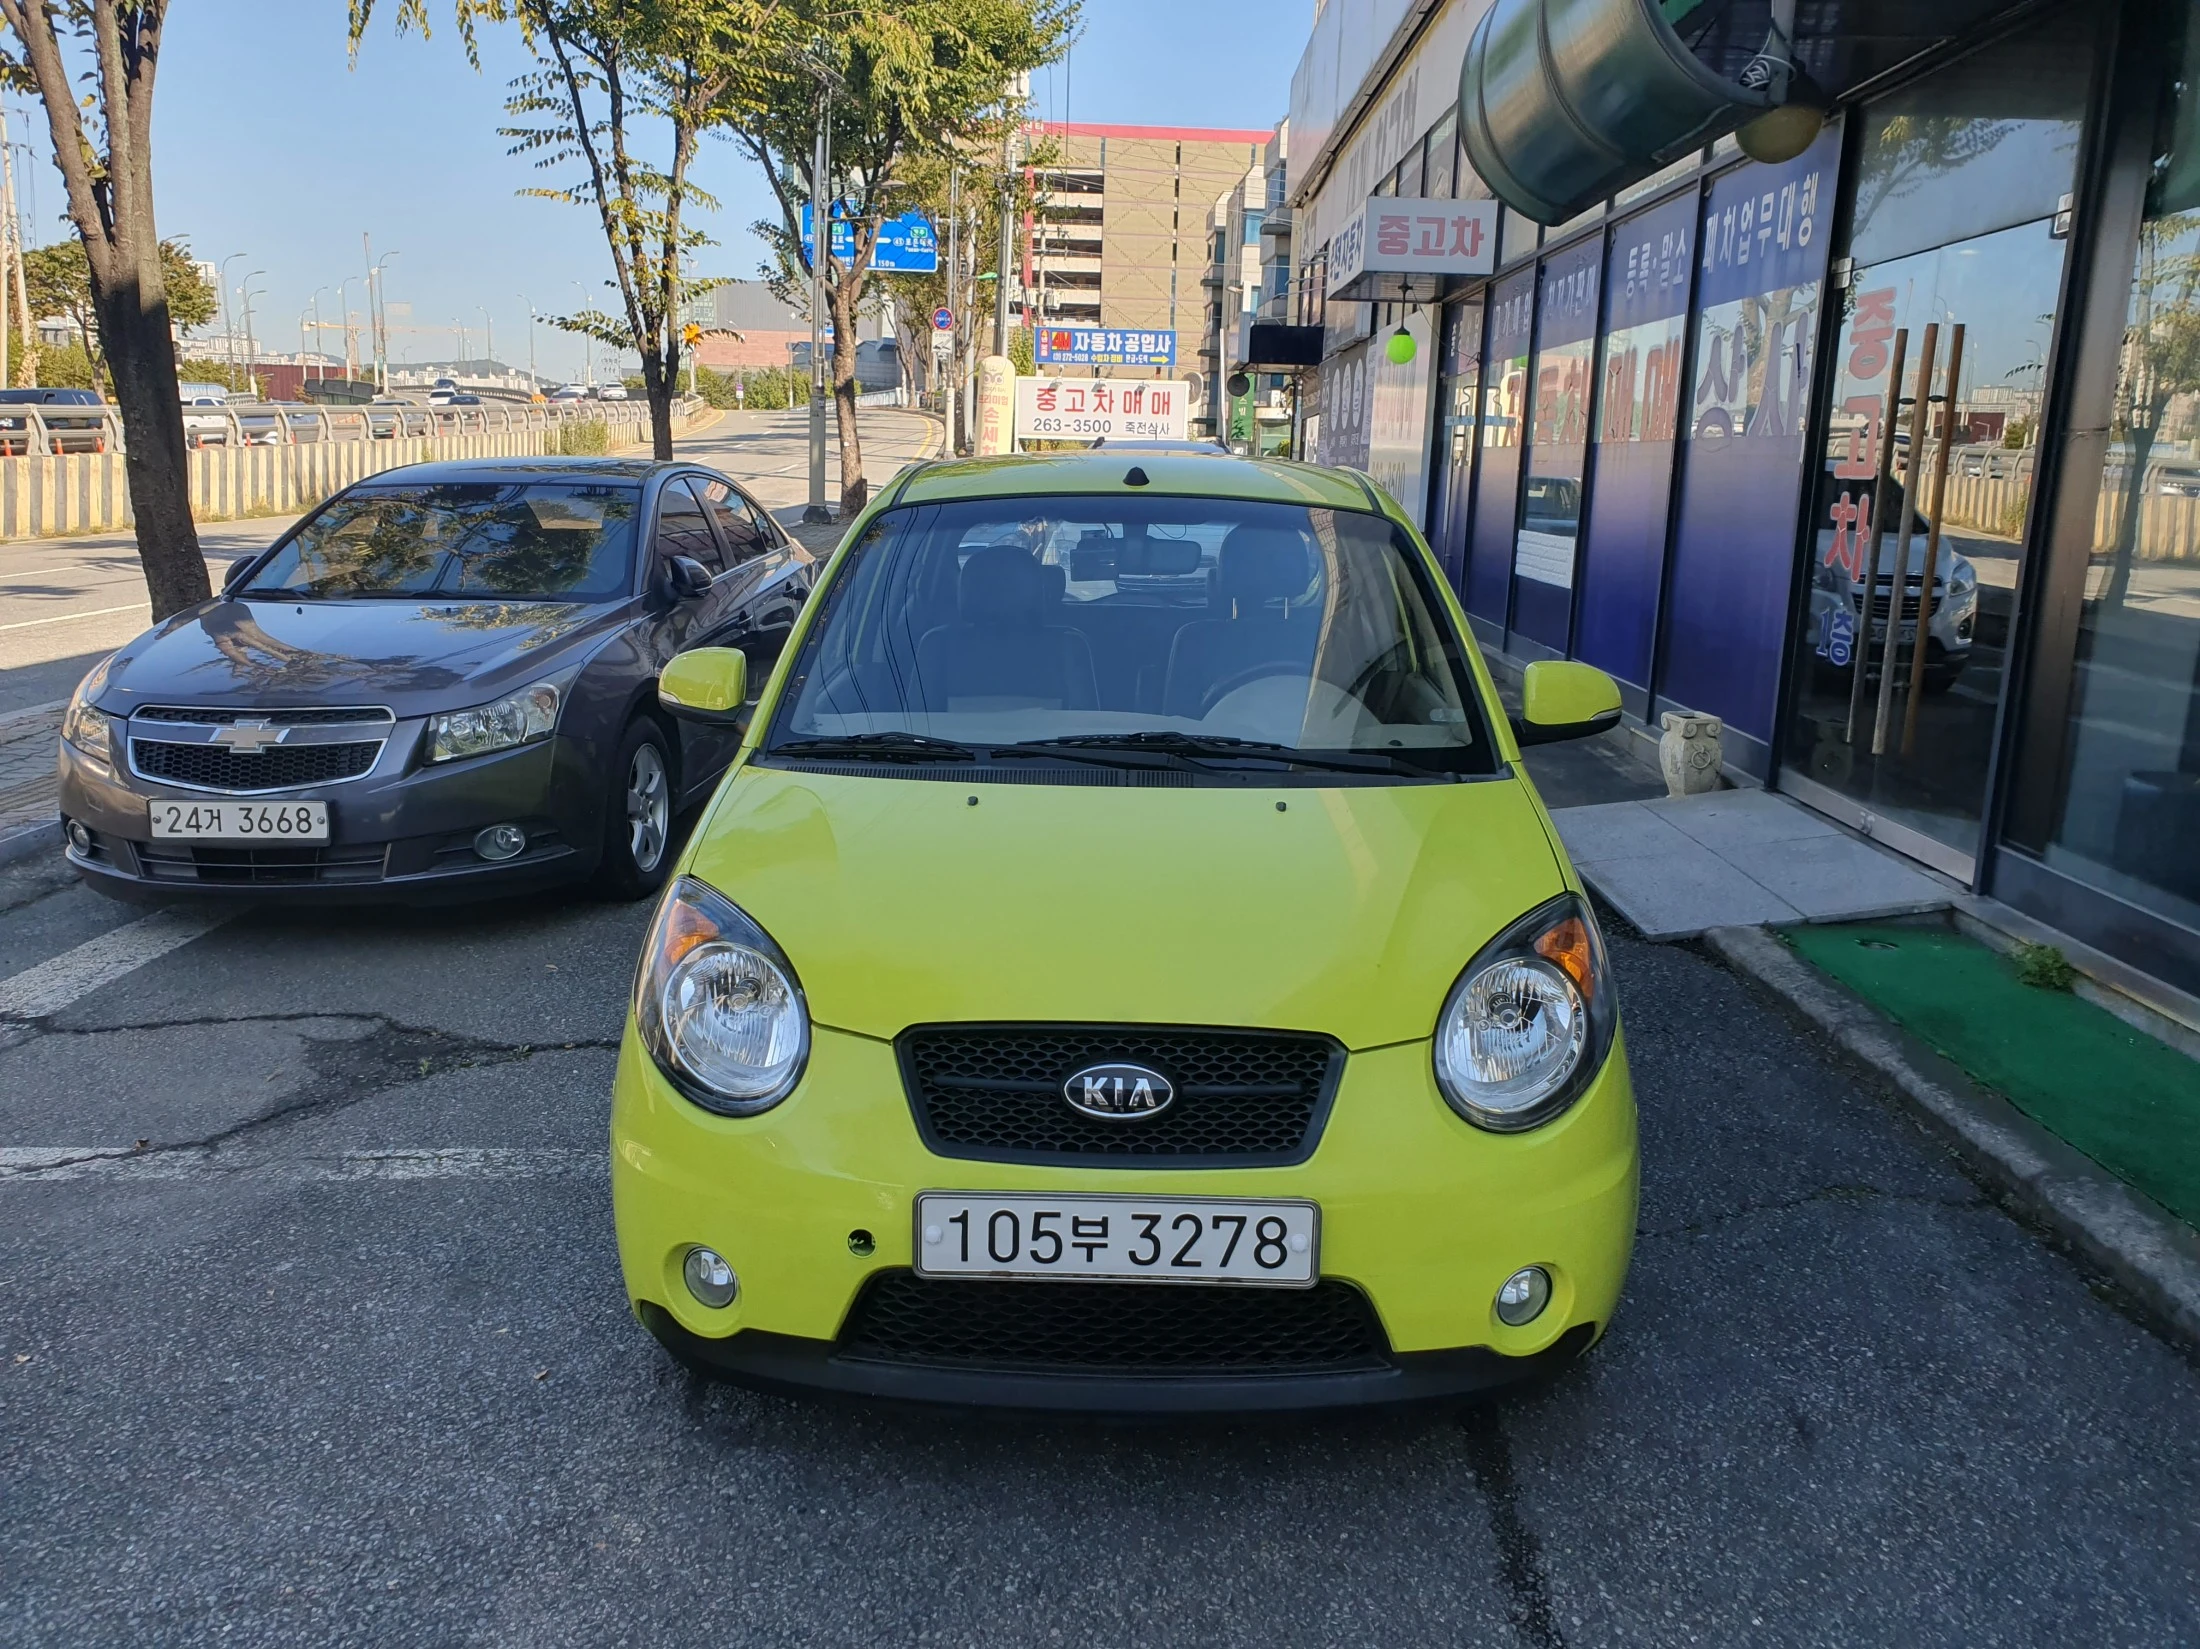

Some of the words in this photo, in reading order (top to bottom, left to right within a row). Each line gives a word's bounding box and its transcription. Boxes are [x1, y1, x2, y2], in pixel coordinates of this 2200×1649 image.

[1377, 215, 1485, 258] 중고차
[1702, 172, 1819, 275] 폐차업무대행
[878, 259, 896, 268] 150m
[1033, 418, 1112, 433] 263-3500
[1125, 421, 1170, 435] 죽전상사
[1824, 286, 1898, 583] 중고차
[1816, 607, 1854, 667] 1층
[166, 806, 222, 834] 24거
[238, 807, 312, 834] 3668
[1083, 1076, 1157, 1108] KIA
[948, 1208, 1109, 1264] 105부
[1128, 1213, 1289, 1269] 3278
